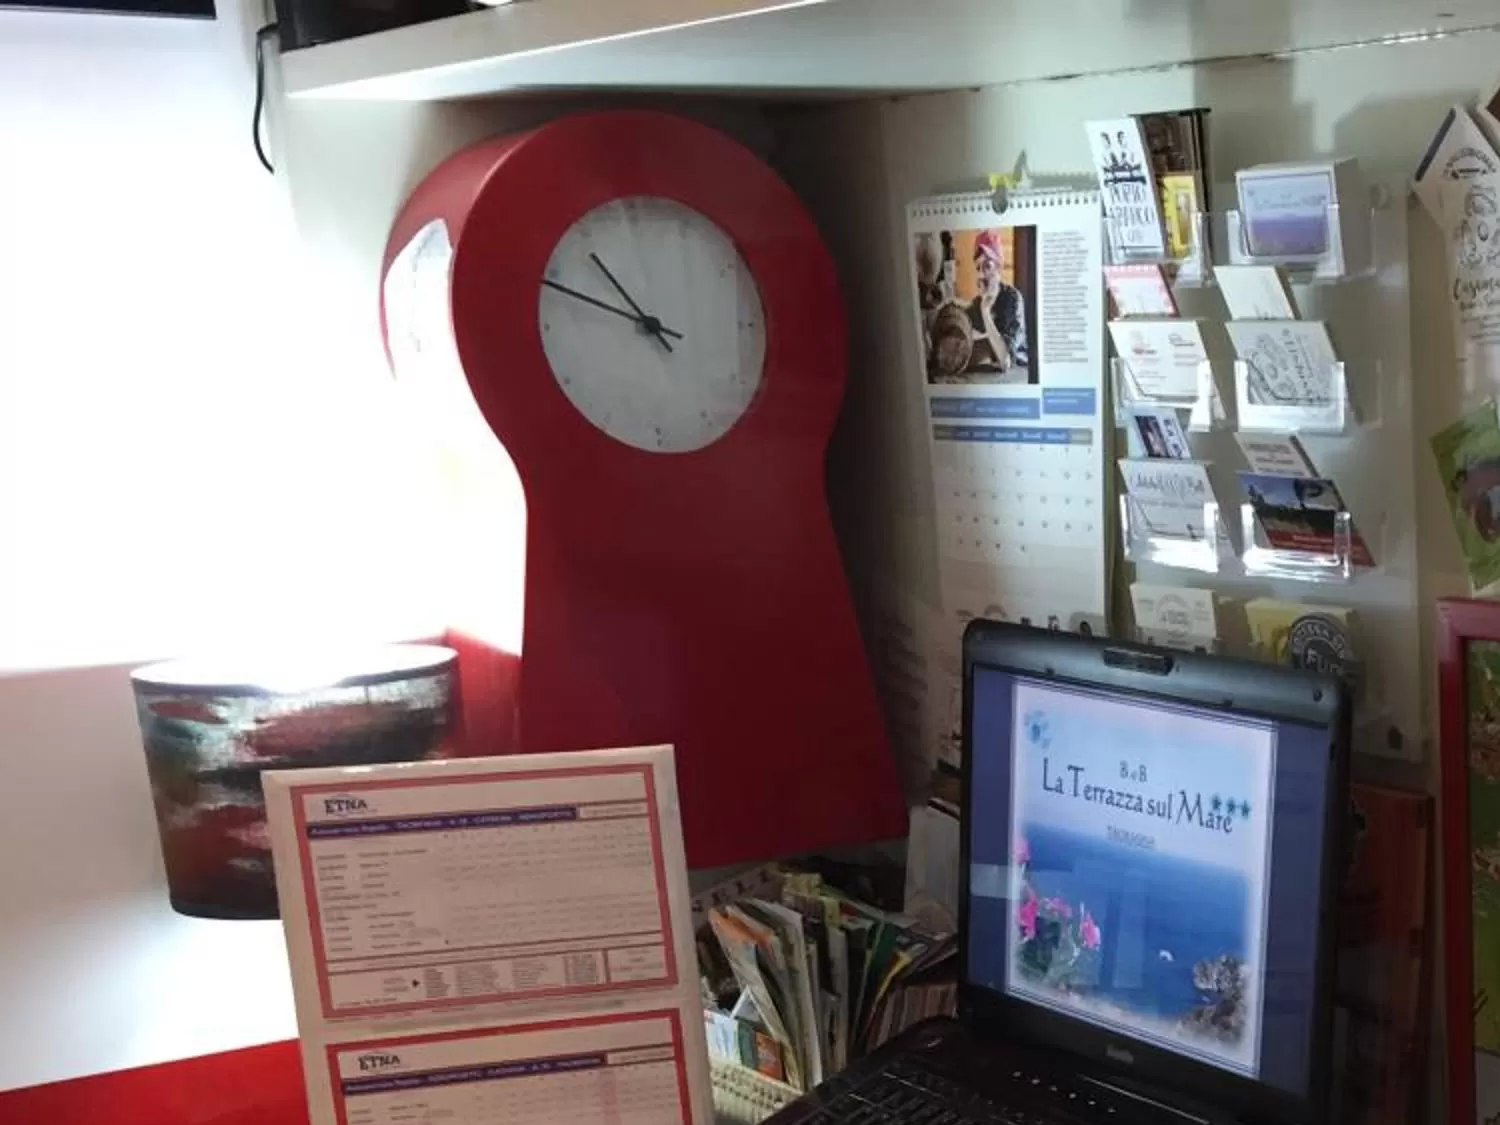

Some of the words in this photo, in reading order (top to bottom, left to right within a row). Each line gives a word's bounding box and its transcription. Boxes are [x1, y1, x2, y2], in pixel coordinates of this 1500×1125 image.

[323, 797, 369, 815] ETNA
[1043, 757, 1065, 795] La
[1067, 763, 1145, 814] Terrazza
[1146, 793, 1174, 822] sul
[1175, 788, 1234, 835] Mare
[357, 1052, 401, 1073] ETNA
